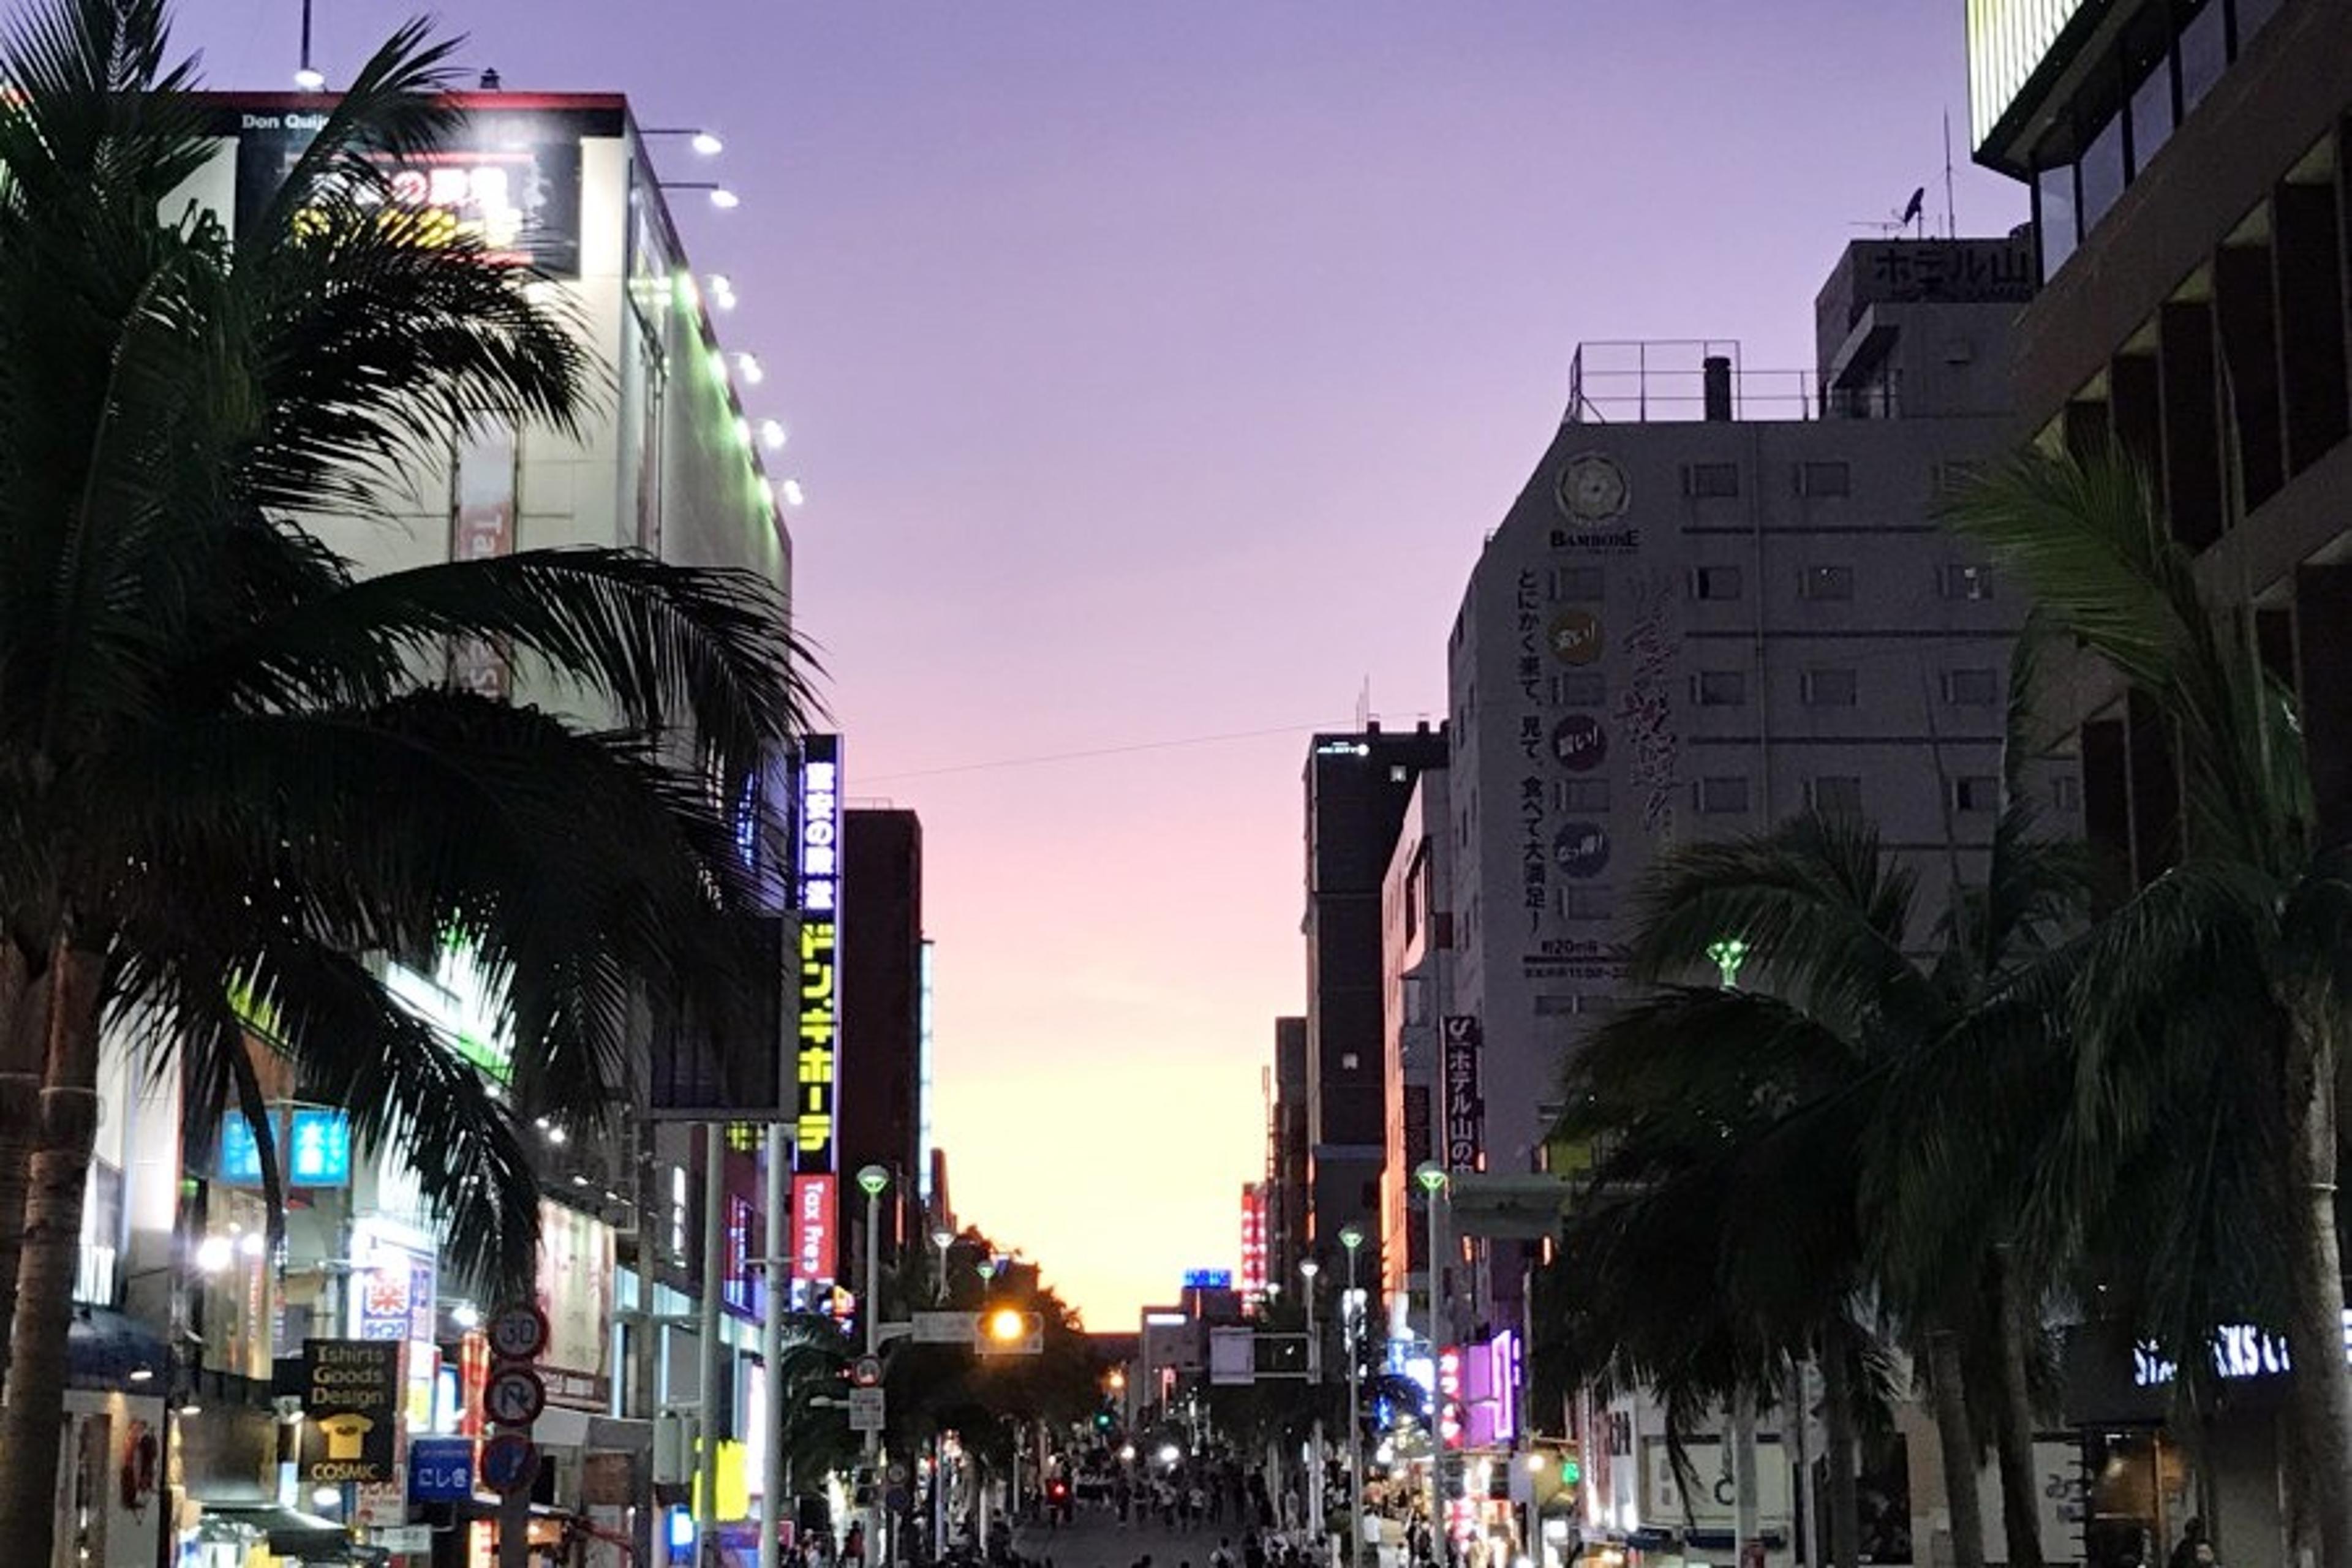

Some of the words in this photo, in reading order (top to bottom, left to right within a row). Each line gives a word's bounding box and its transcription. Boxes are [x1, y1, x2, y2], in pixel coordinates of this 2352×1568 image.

[242, 114, 280, 129] Don
[284, 114, 333, 132] Quij
[804, 1183, 824, 1221] Tax
[502, 1319, 535, 1344] 30
[312, 1366, 385, 1385] Goods
[311, 1387, 385, 1409] Design
[311, 1463, 380, 1480] COSMIC
